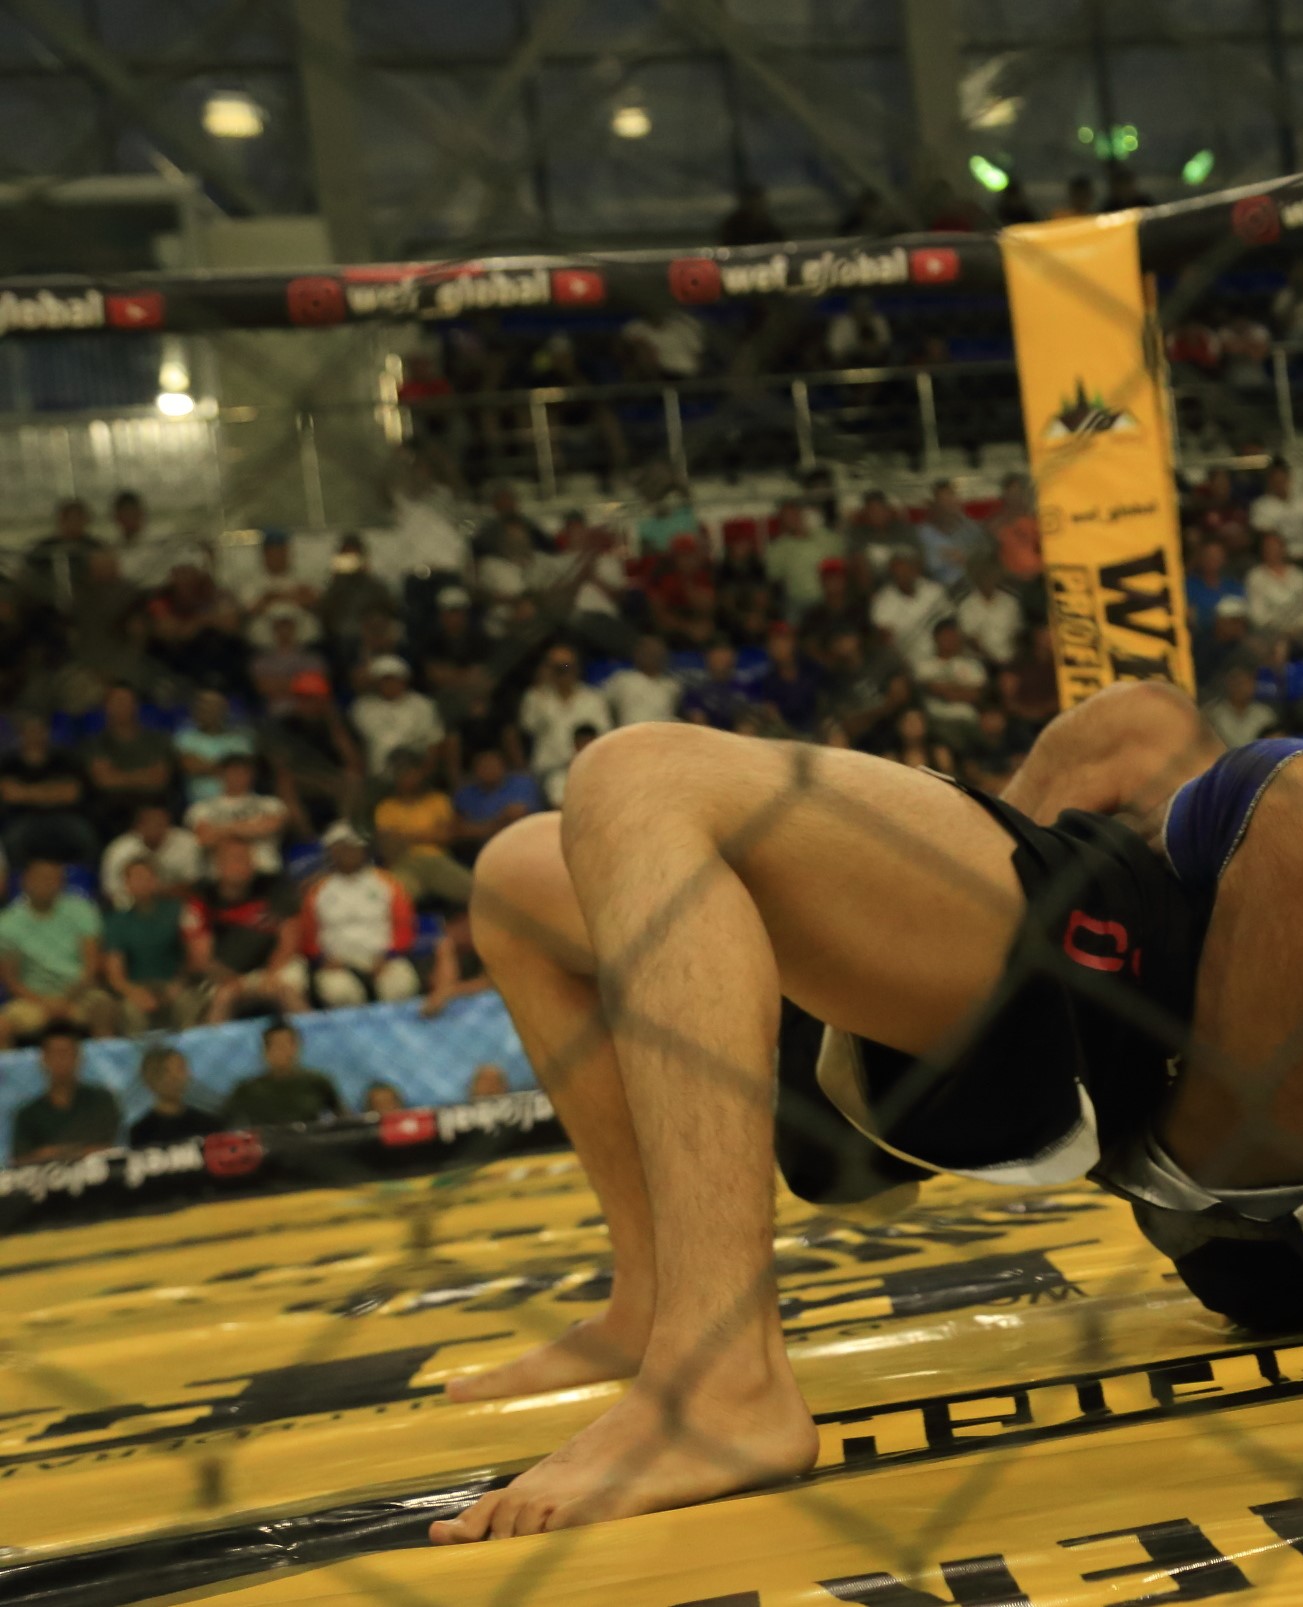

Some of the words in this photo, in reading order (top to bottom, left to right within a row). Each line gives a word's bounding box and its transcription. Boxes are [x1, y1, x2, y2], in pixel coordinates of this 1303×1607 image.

[721, 247, 908, 297] wef_global
[0, 288, 105, 336] lobal
[0, 1139, 204, 1200] wef_globa
